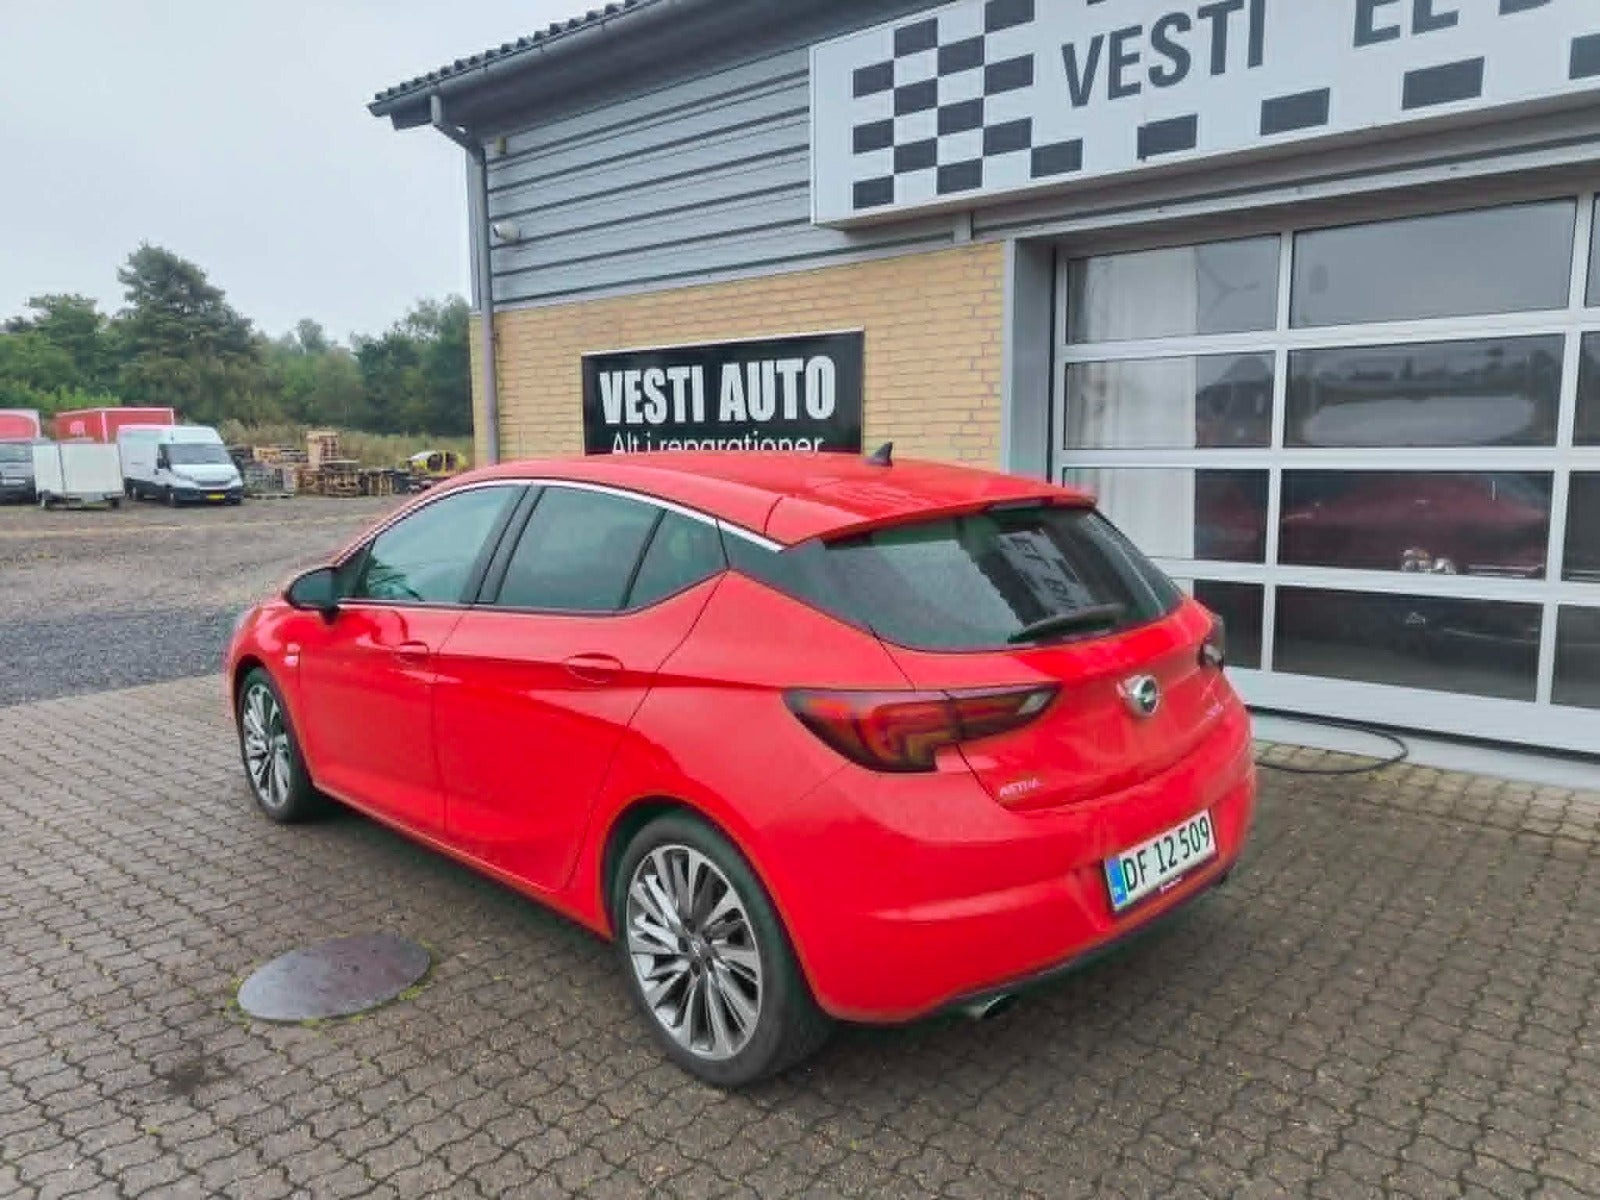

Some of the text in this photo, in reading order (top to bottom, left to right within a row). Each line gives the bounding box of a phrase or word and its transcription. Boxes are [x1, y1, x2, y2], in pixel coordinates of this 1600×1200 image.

[1061, 0, 1265, 107] VESTI
[600, 355, 836, 424] VESTI AUTO
[612, 431, 639, 454] Alt
[1122, 849, 1147, 891] DF
